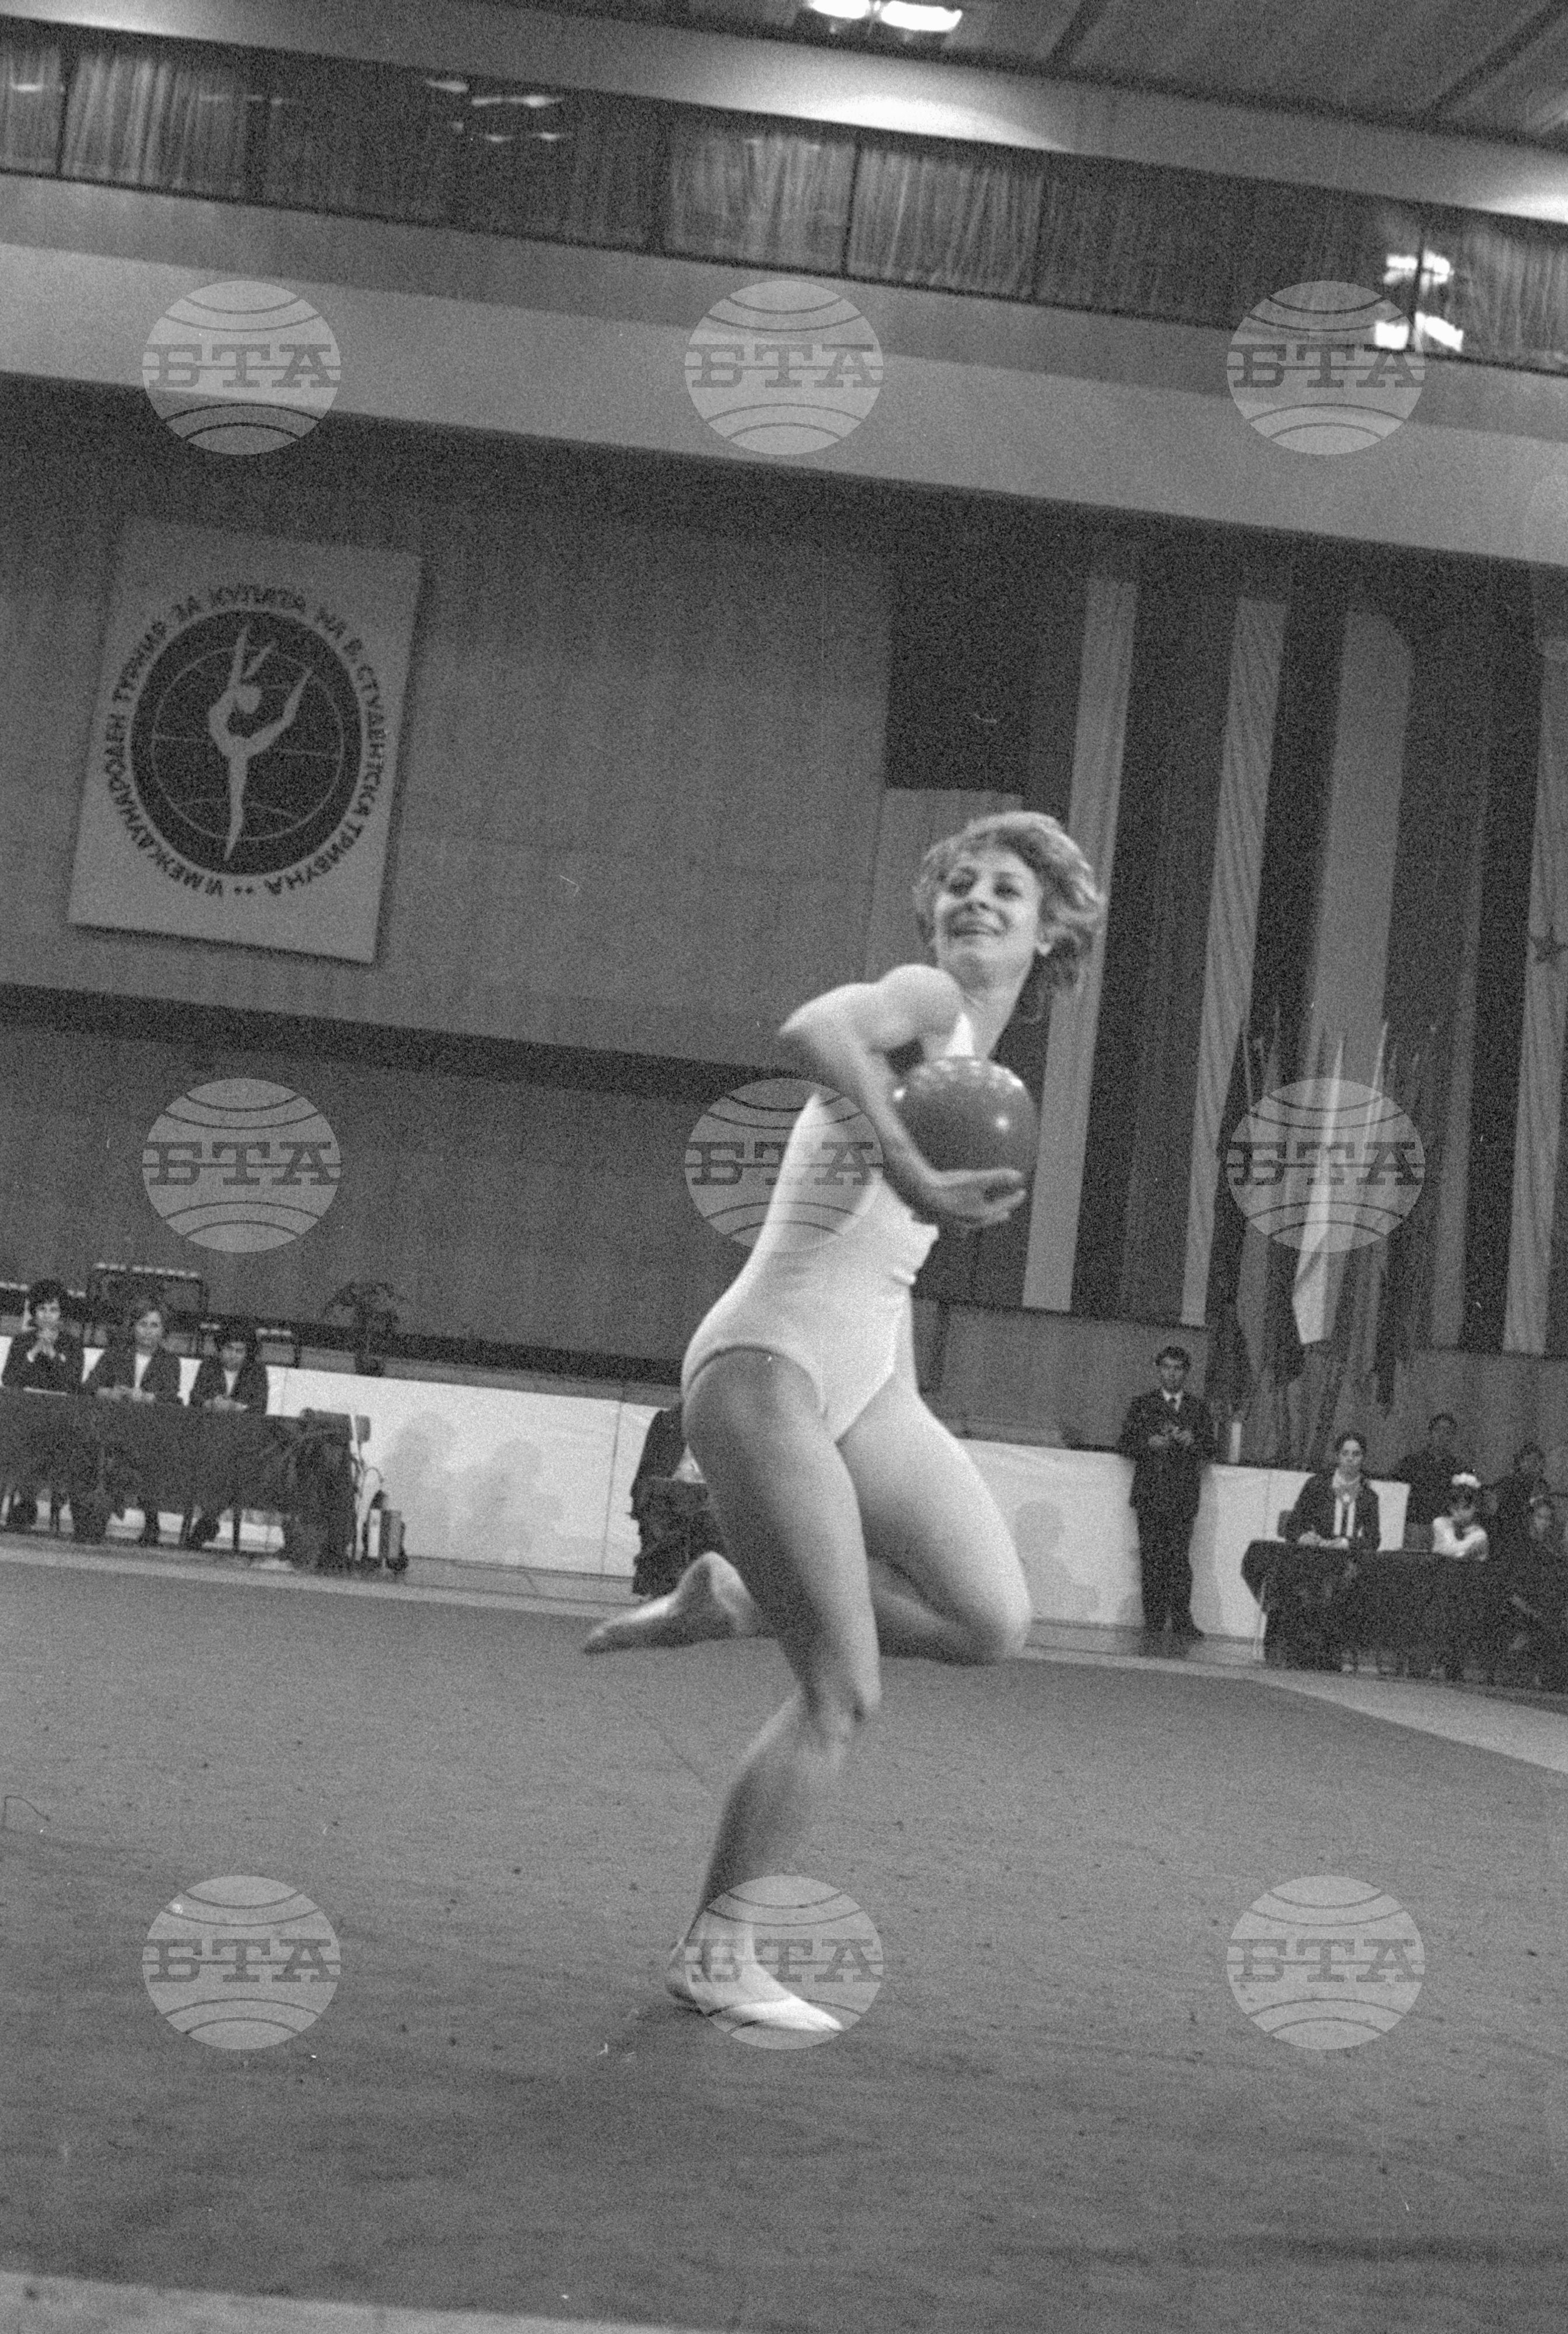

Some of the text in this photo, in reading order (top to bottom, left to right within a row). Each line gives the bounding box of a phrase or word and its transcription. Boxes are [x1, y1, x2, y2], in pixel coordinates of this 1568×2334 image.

[171, 595, 201, 620] ЗА
[357, 663, 387, 816] СТУДЕНТСКА
[104, 713, 205, 892] МЕЖДУНАРОДЕН
[263, 821, 366, 897] ТРИБУНА
